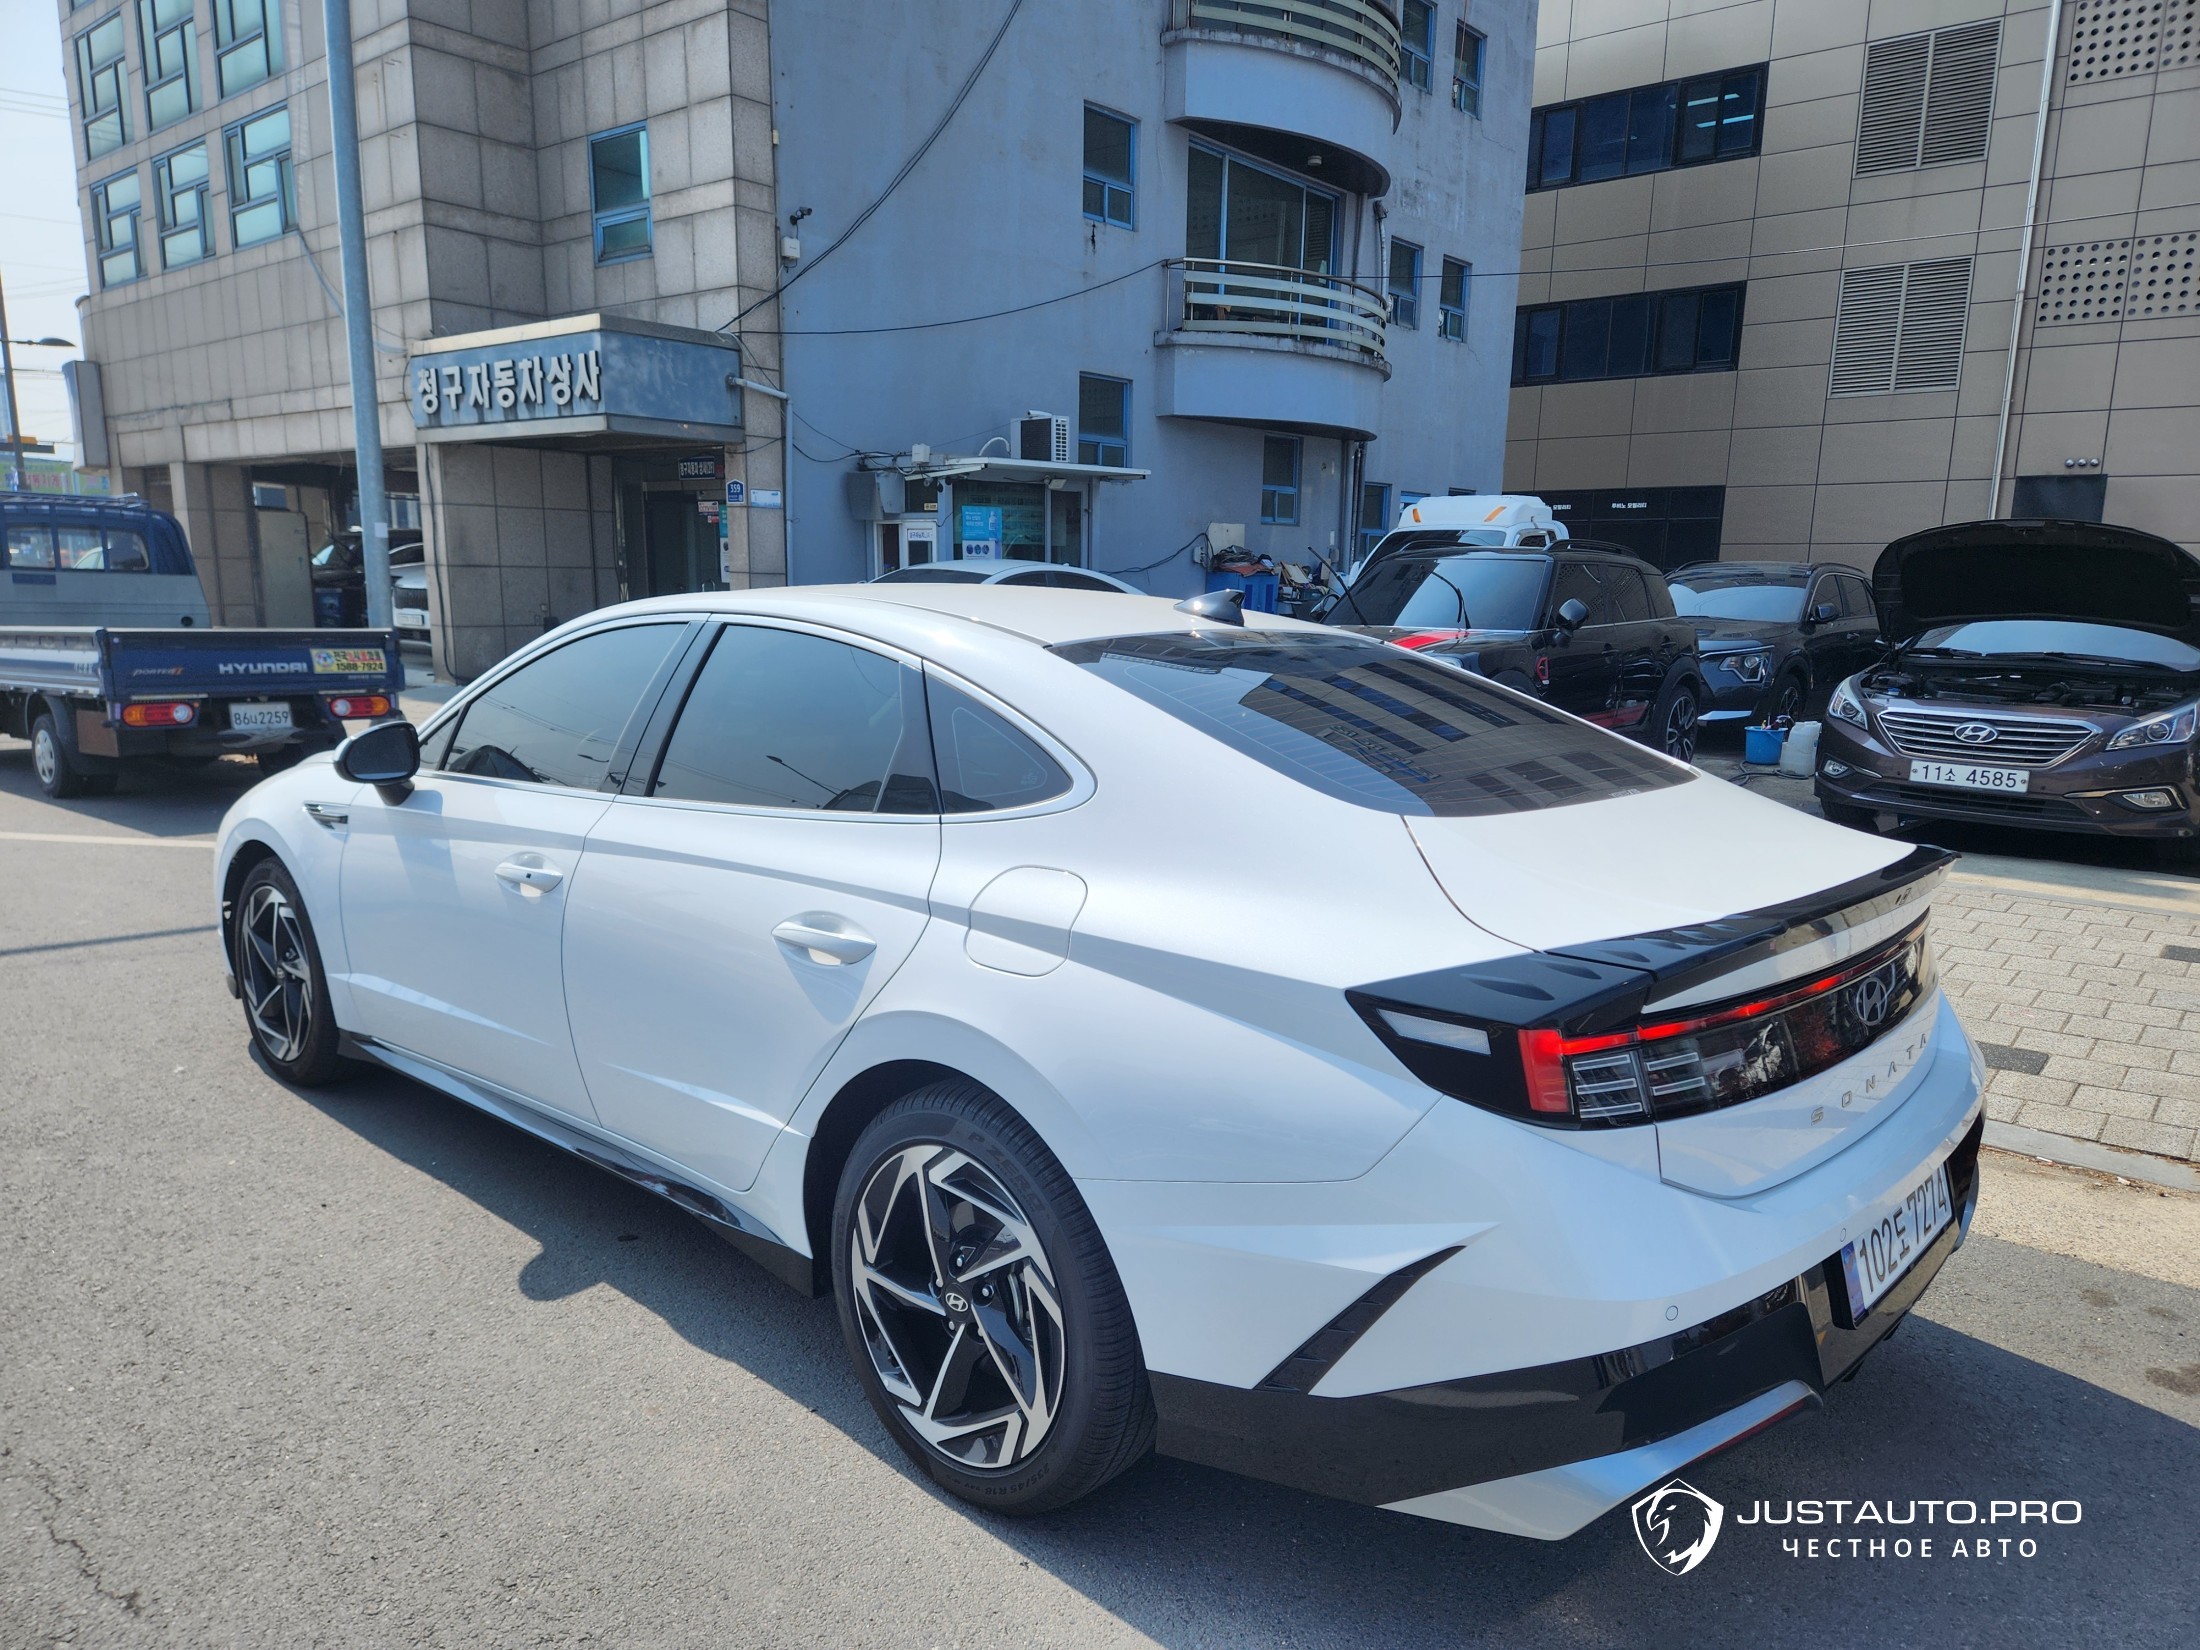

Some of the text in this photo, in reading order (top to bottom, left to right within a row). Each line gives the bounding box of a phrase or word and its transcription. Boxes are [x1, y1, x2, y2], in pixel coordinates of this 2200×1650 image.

[417, 350, 600, 415] 청구자동차상사
[730, 484, 741, 493] 359
[219, 662, 308, 675] HYUNDAI
[336, 662, 384, 671] 1588-7924
[234, 710, 289, 726] 86나2259
[1922, 764, 2018, 788] 11소 4585
[1811, 1033, 1927, 1127] SONATA
[1859, 1166, 1948, 1293] 102도7274
